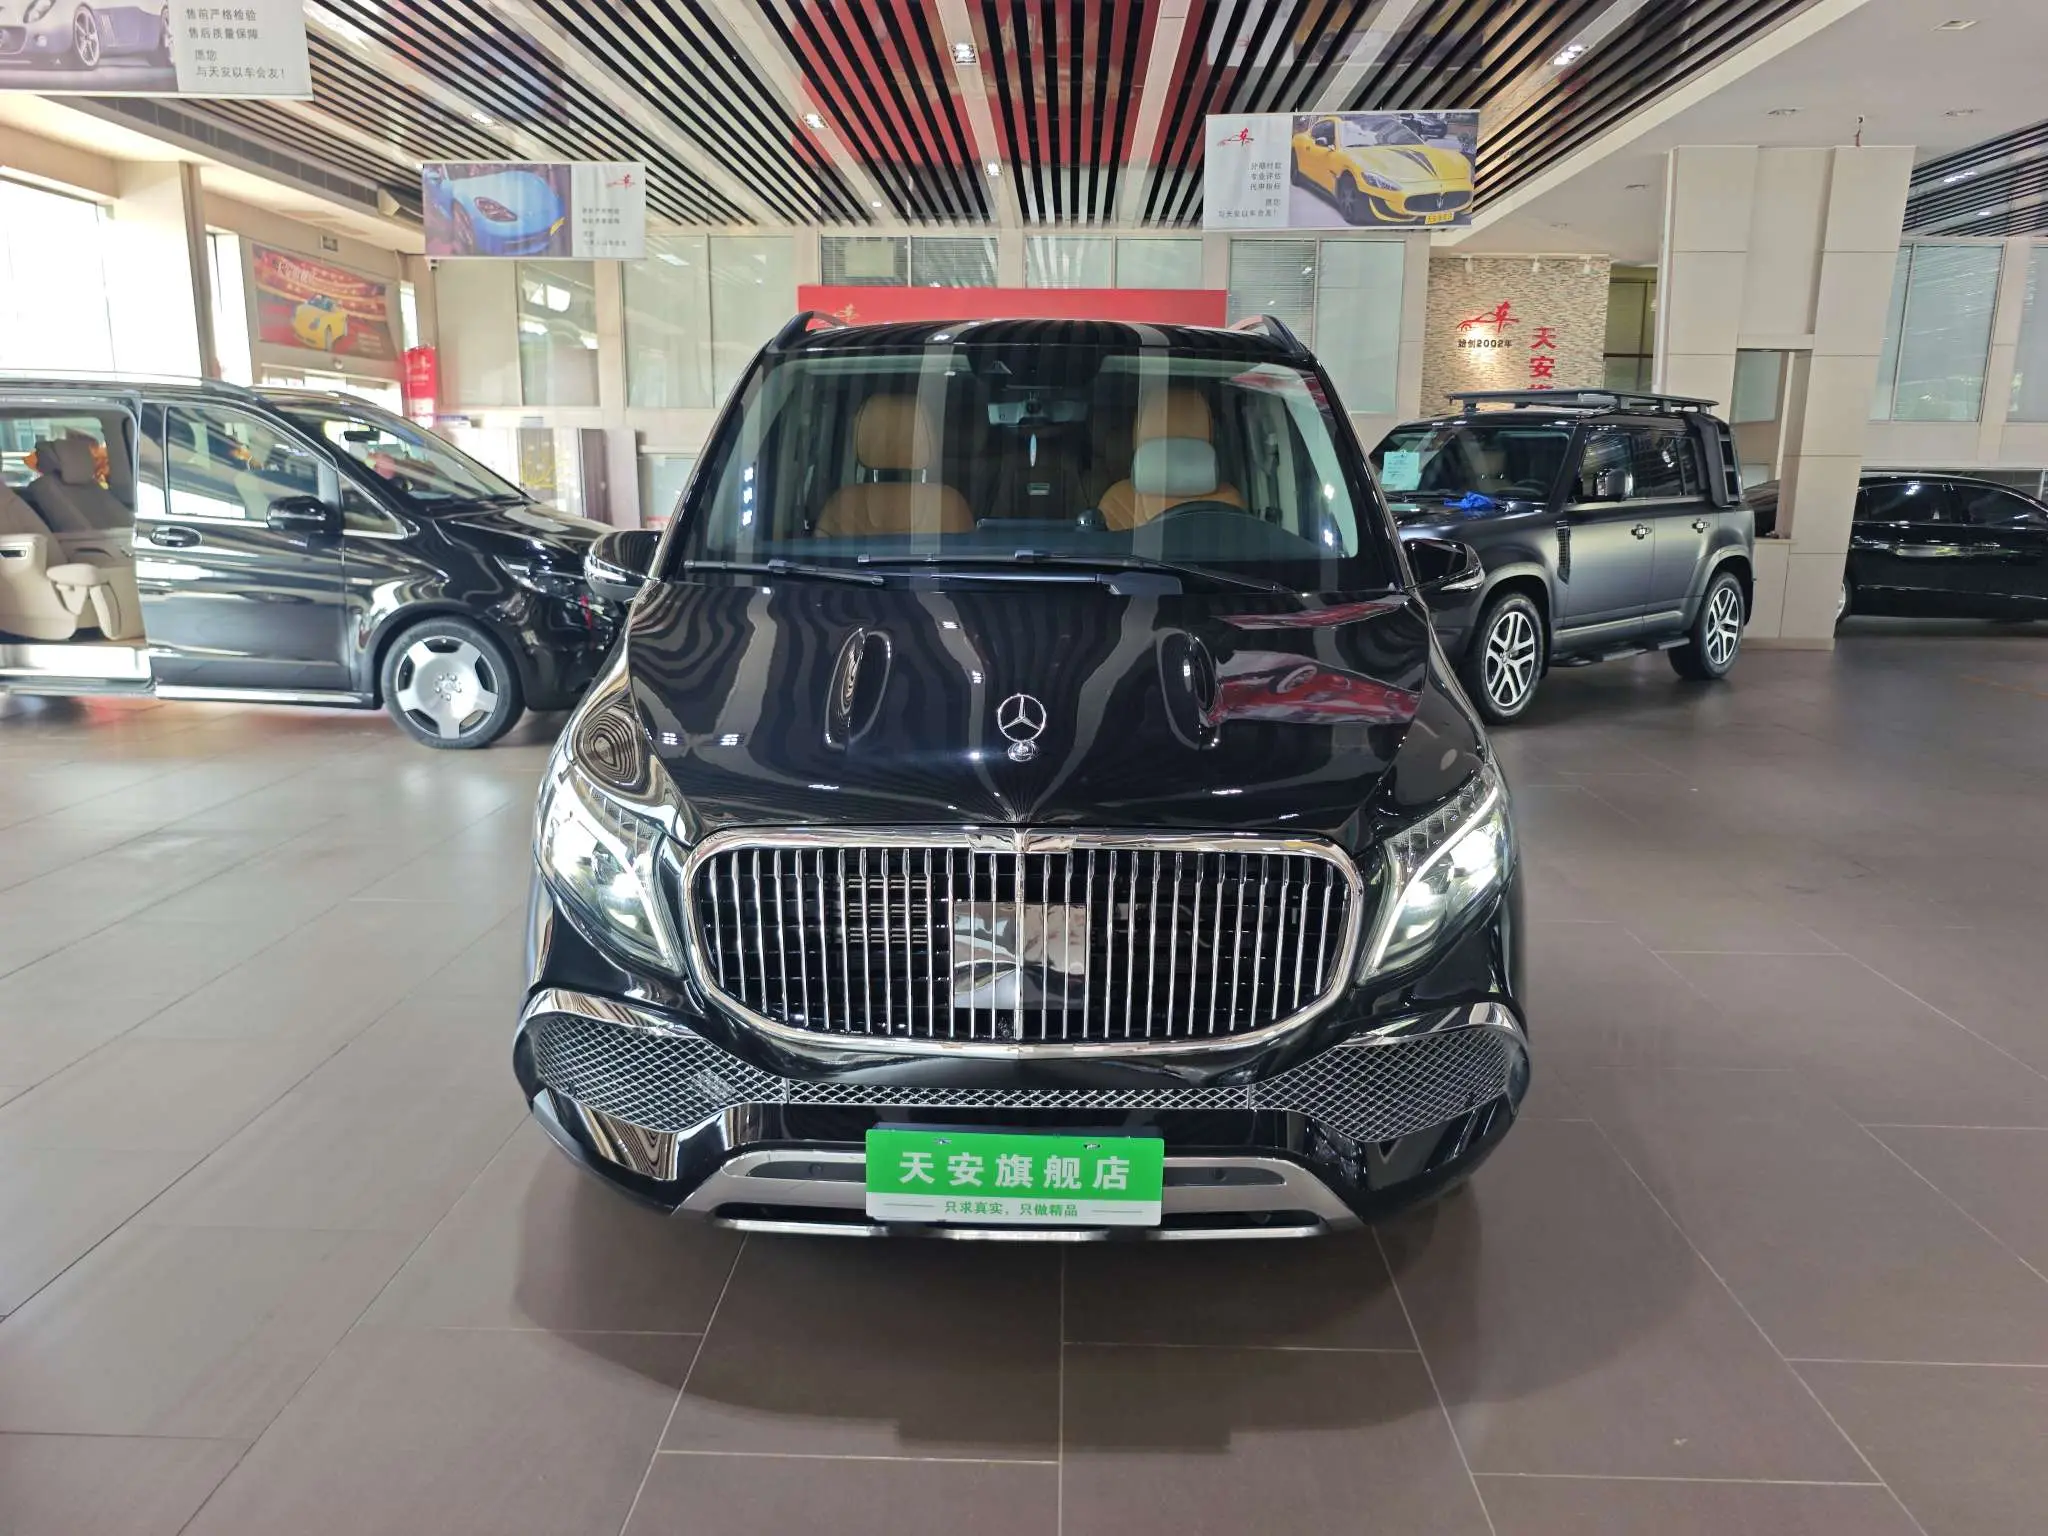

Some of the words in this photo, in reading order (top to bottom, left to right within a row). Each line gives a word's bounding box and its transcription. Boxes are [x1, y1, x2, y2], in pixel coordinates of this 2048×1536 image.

[186, 8, 257, 21] 售前严格检验
[188, 27, 259, 40] 售后质量保障
[1527, 326, 1557, 390] 天安
[899, 1151, 1131, 1190] 天安旗舰店
[944, 1200, 1079, 1218] 只求真实，只做精品
